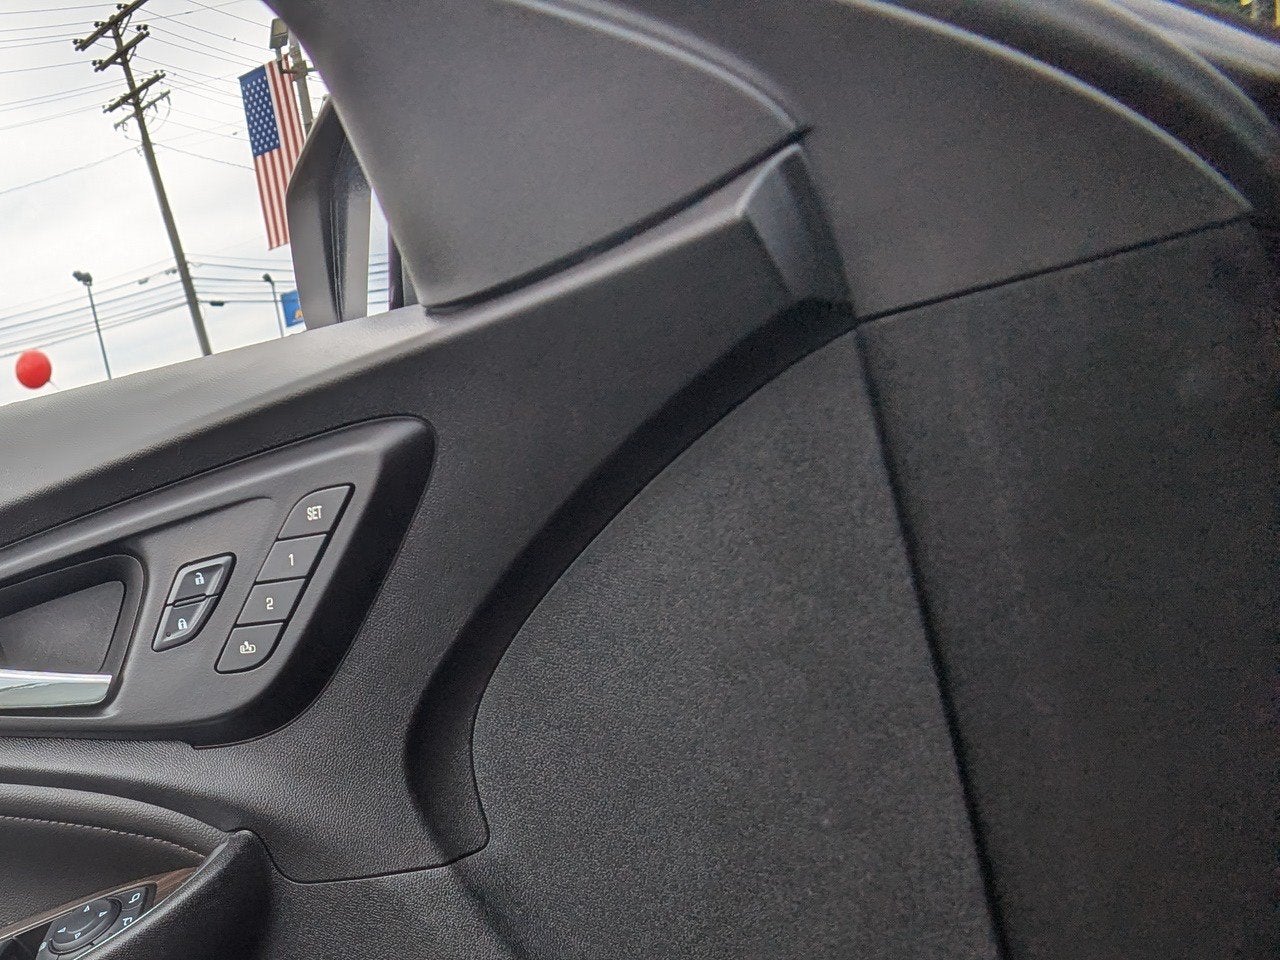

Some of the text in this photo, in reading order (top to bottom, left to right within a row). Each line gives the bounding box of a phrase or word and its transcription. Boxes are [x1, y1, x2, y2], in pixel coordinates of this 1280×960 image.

[306, 505, 323, 521] SET
[288, 553, 294, 566] 1
[266, 597, 274, 610] 2
